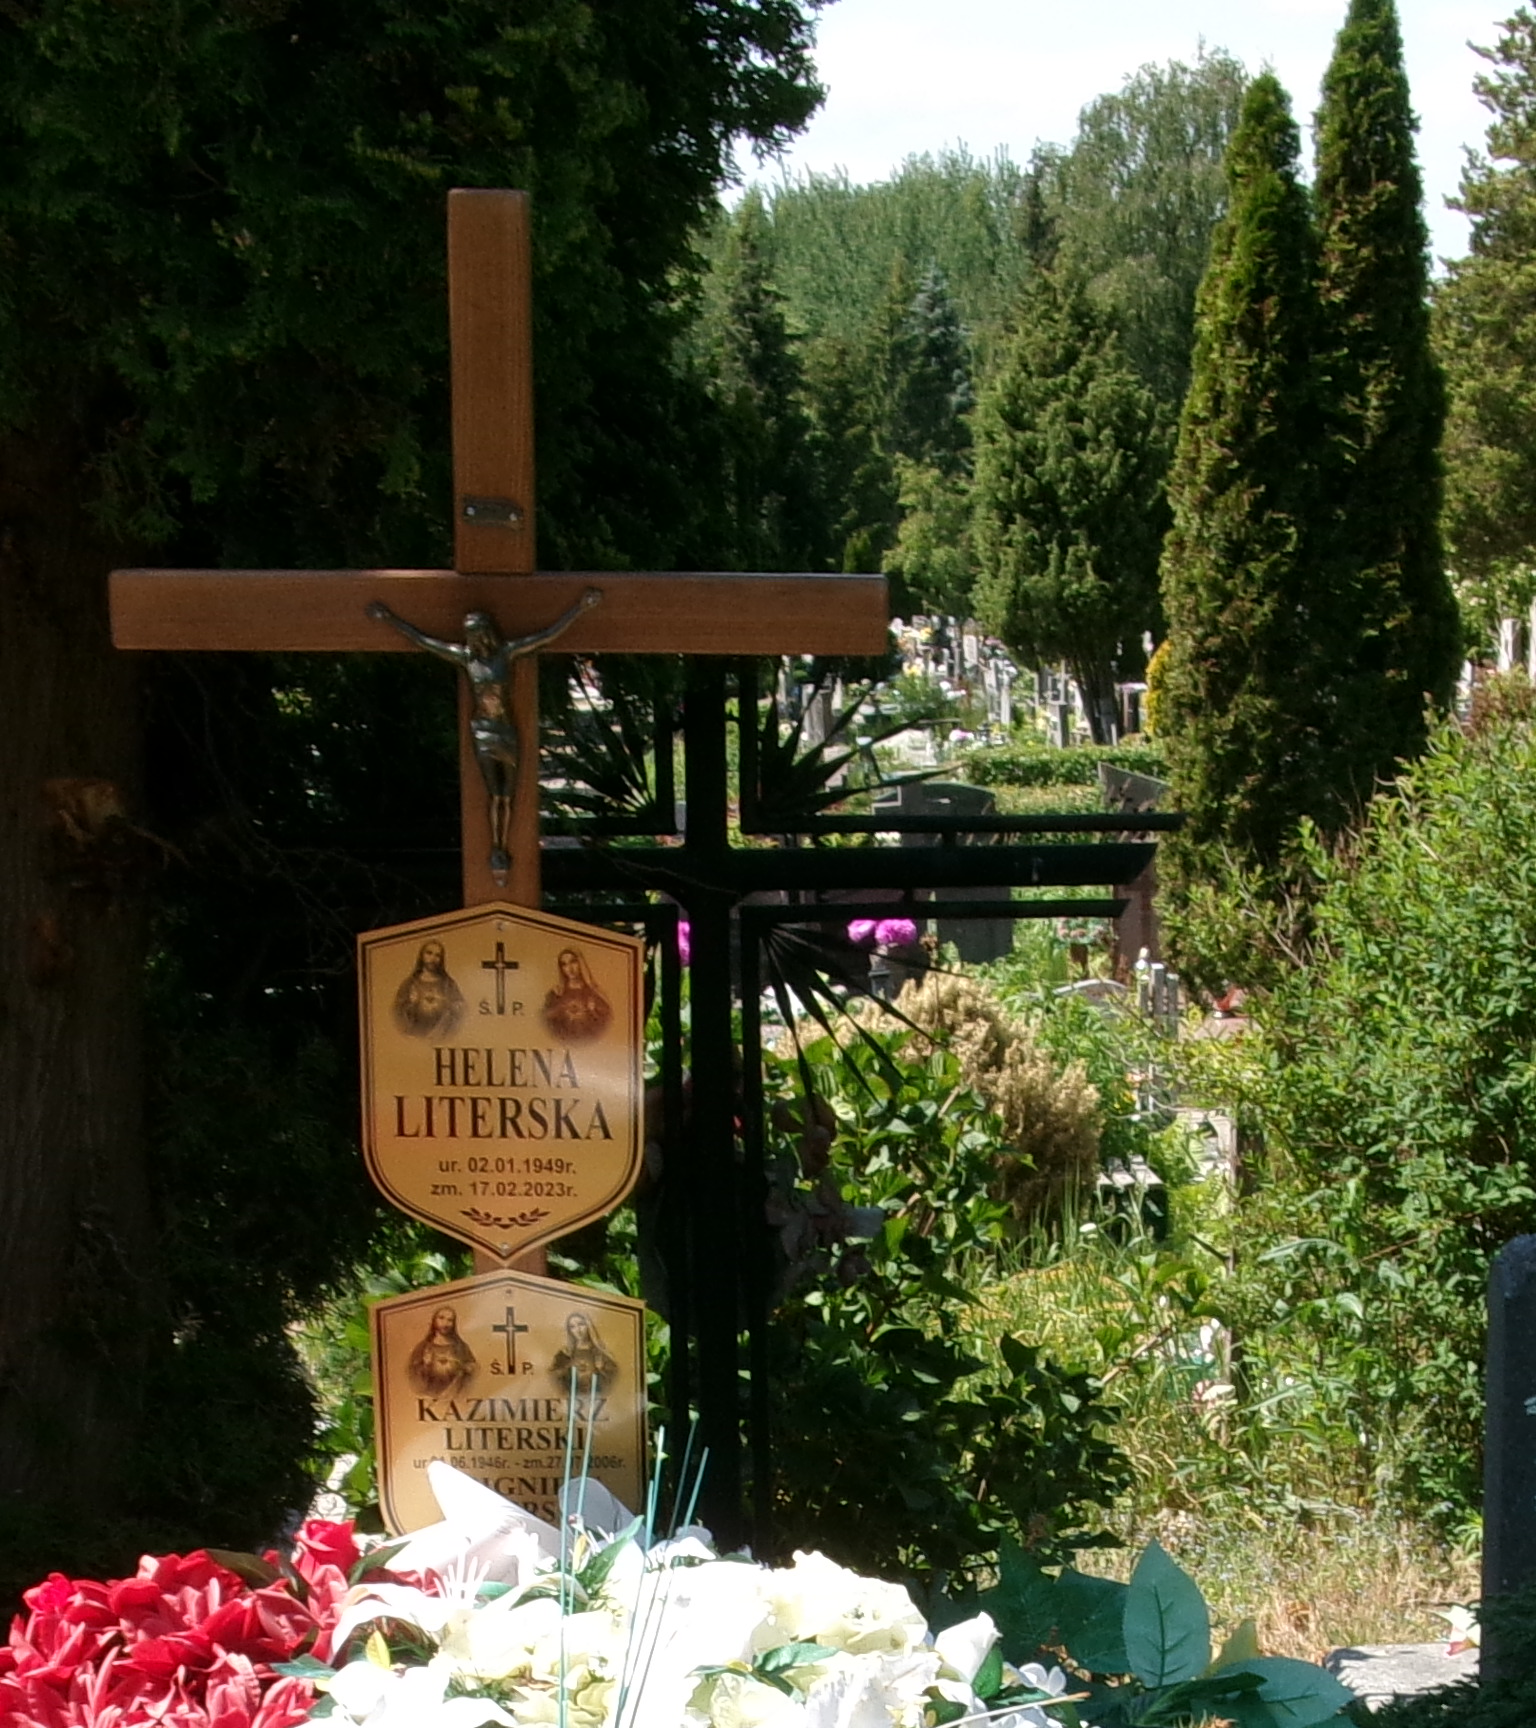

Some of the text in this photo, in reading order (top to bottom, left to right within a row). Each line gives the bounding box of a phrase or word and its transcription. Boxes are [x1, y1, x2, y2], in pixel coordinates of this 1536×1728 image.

[433, 1047, 581, 1088] HELENA
[393, 1095, 614, 1140] LITERSKA
[438, 1156, 577, 1175] ur. 02.01.1949r.
[430, 1181, 578, 1198] zm. 17.02.2023r.
[417, 1398, 610, 1422] KAZIMIERZ
[444, 1427, 585, 1451] LITERSKI
